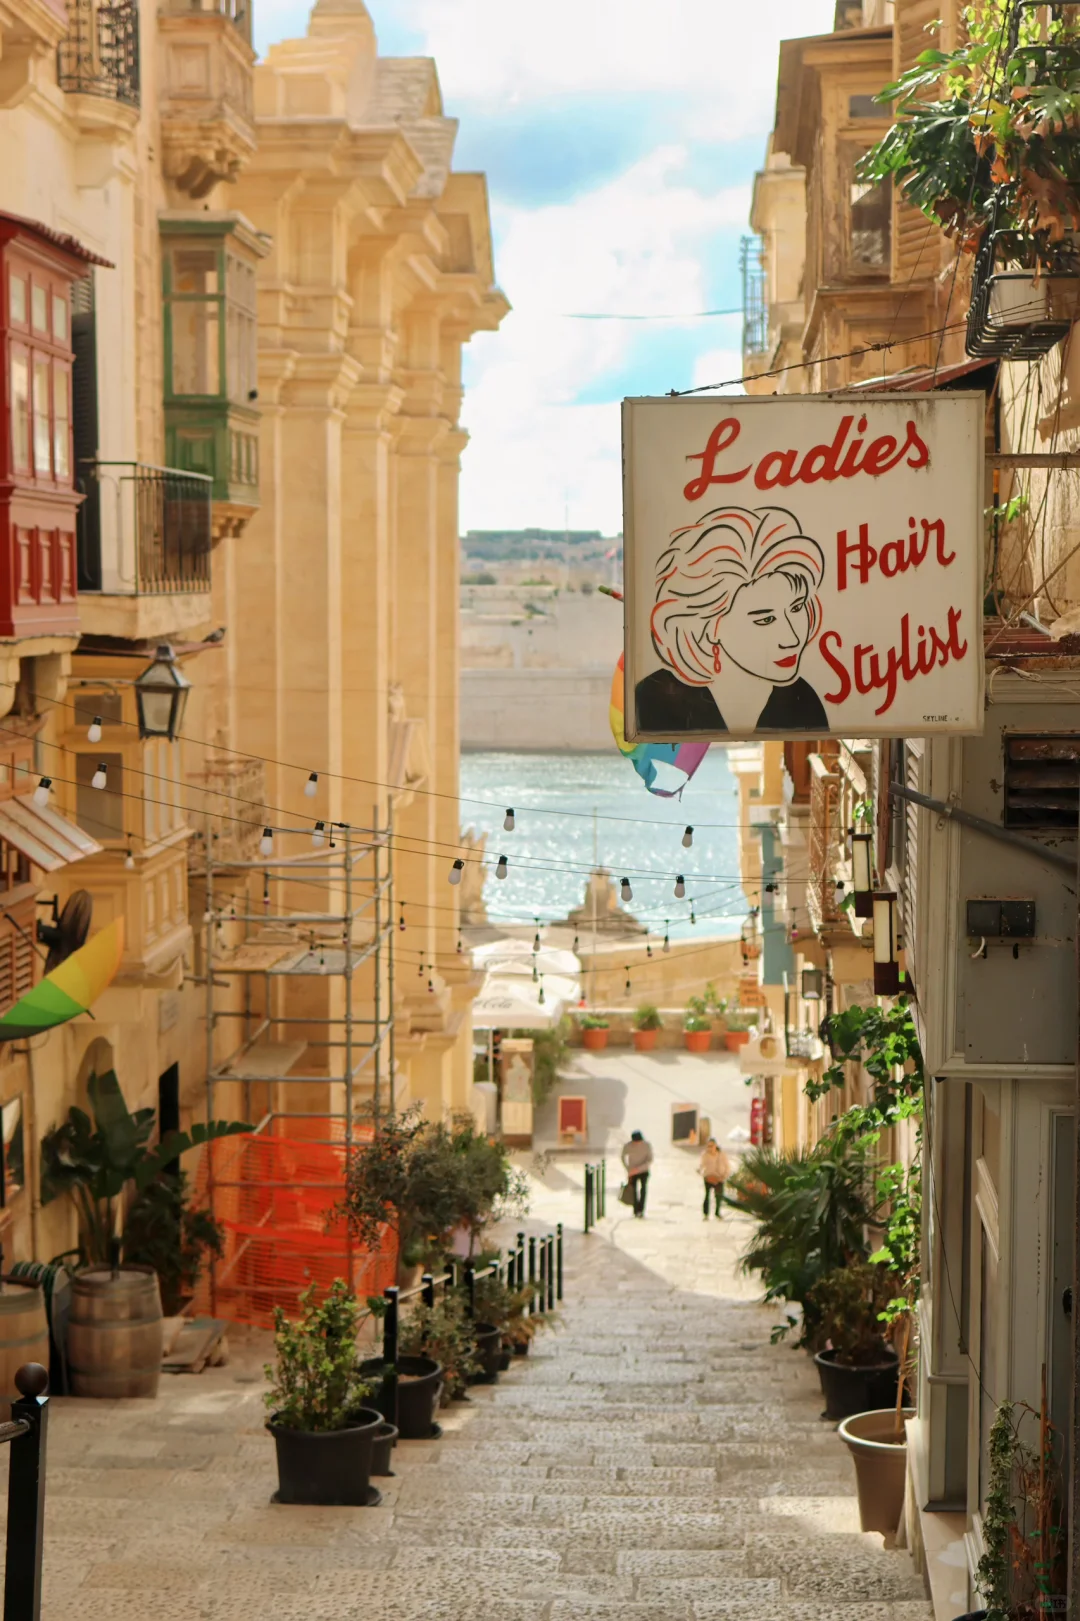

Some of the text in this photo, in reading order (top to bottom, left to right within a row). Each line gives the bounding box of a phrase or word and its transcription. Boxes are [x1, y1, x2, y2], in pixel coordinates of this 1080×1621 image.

[683, 414, 930, 501] Ladies
[836, 516, 956, 592] Hair
[818, 605, 968, 716] Stylist
[922, 714, 949, 722] SKYLINE
